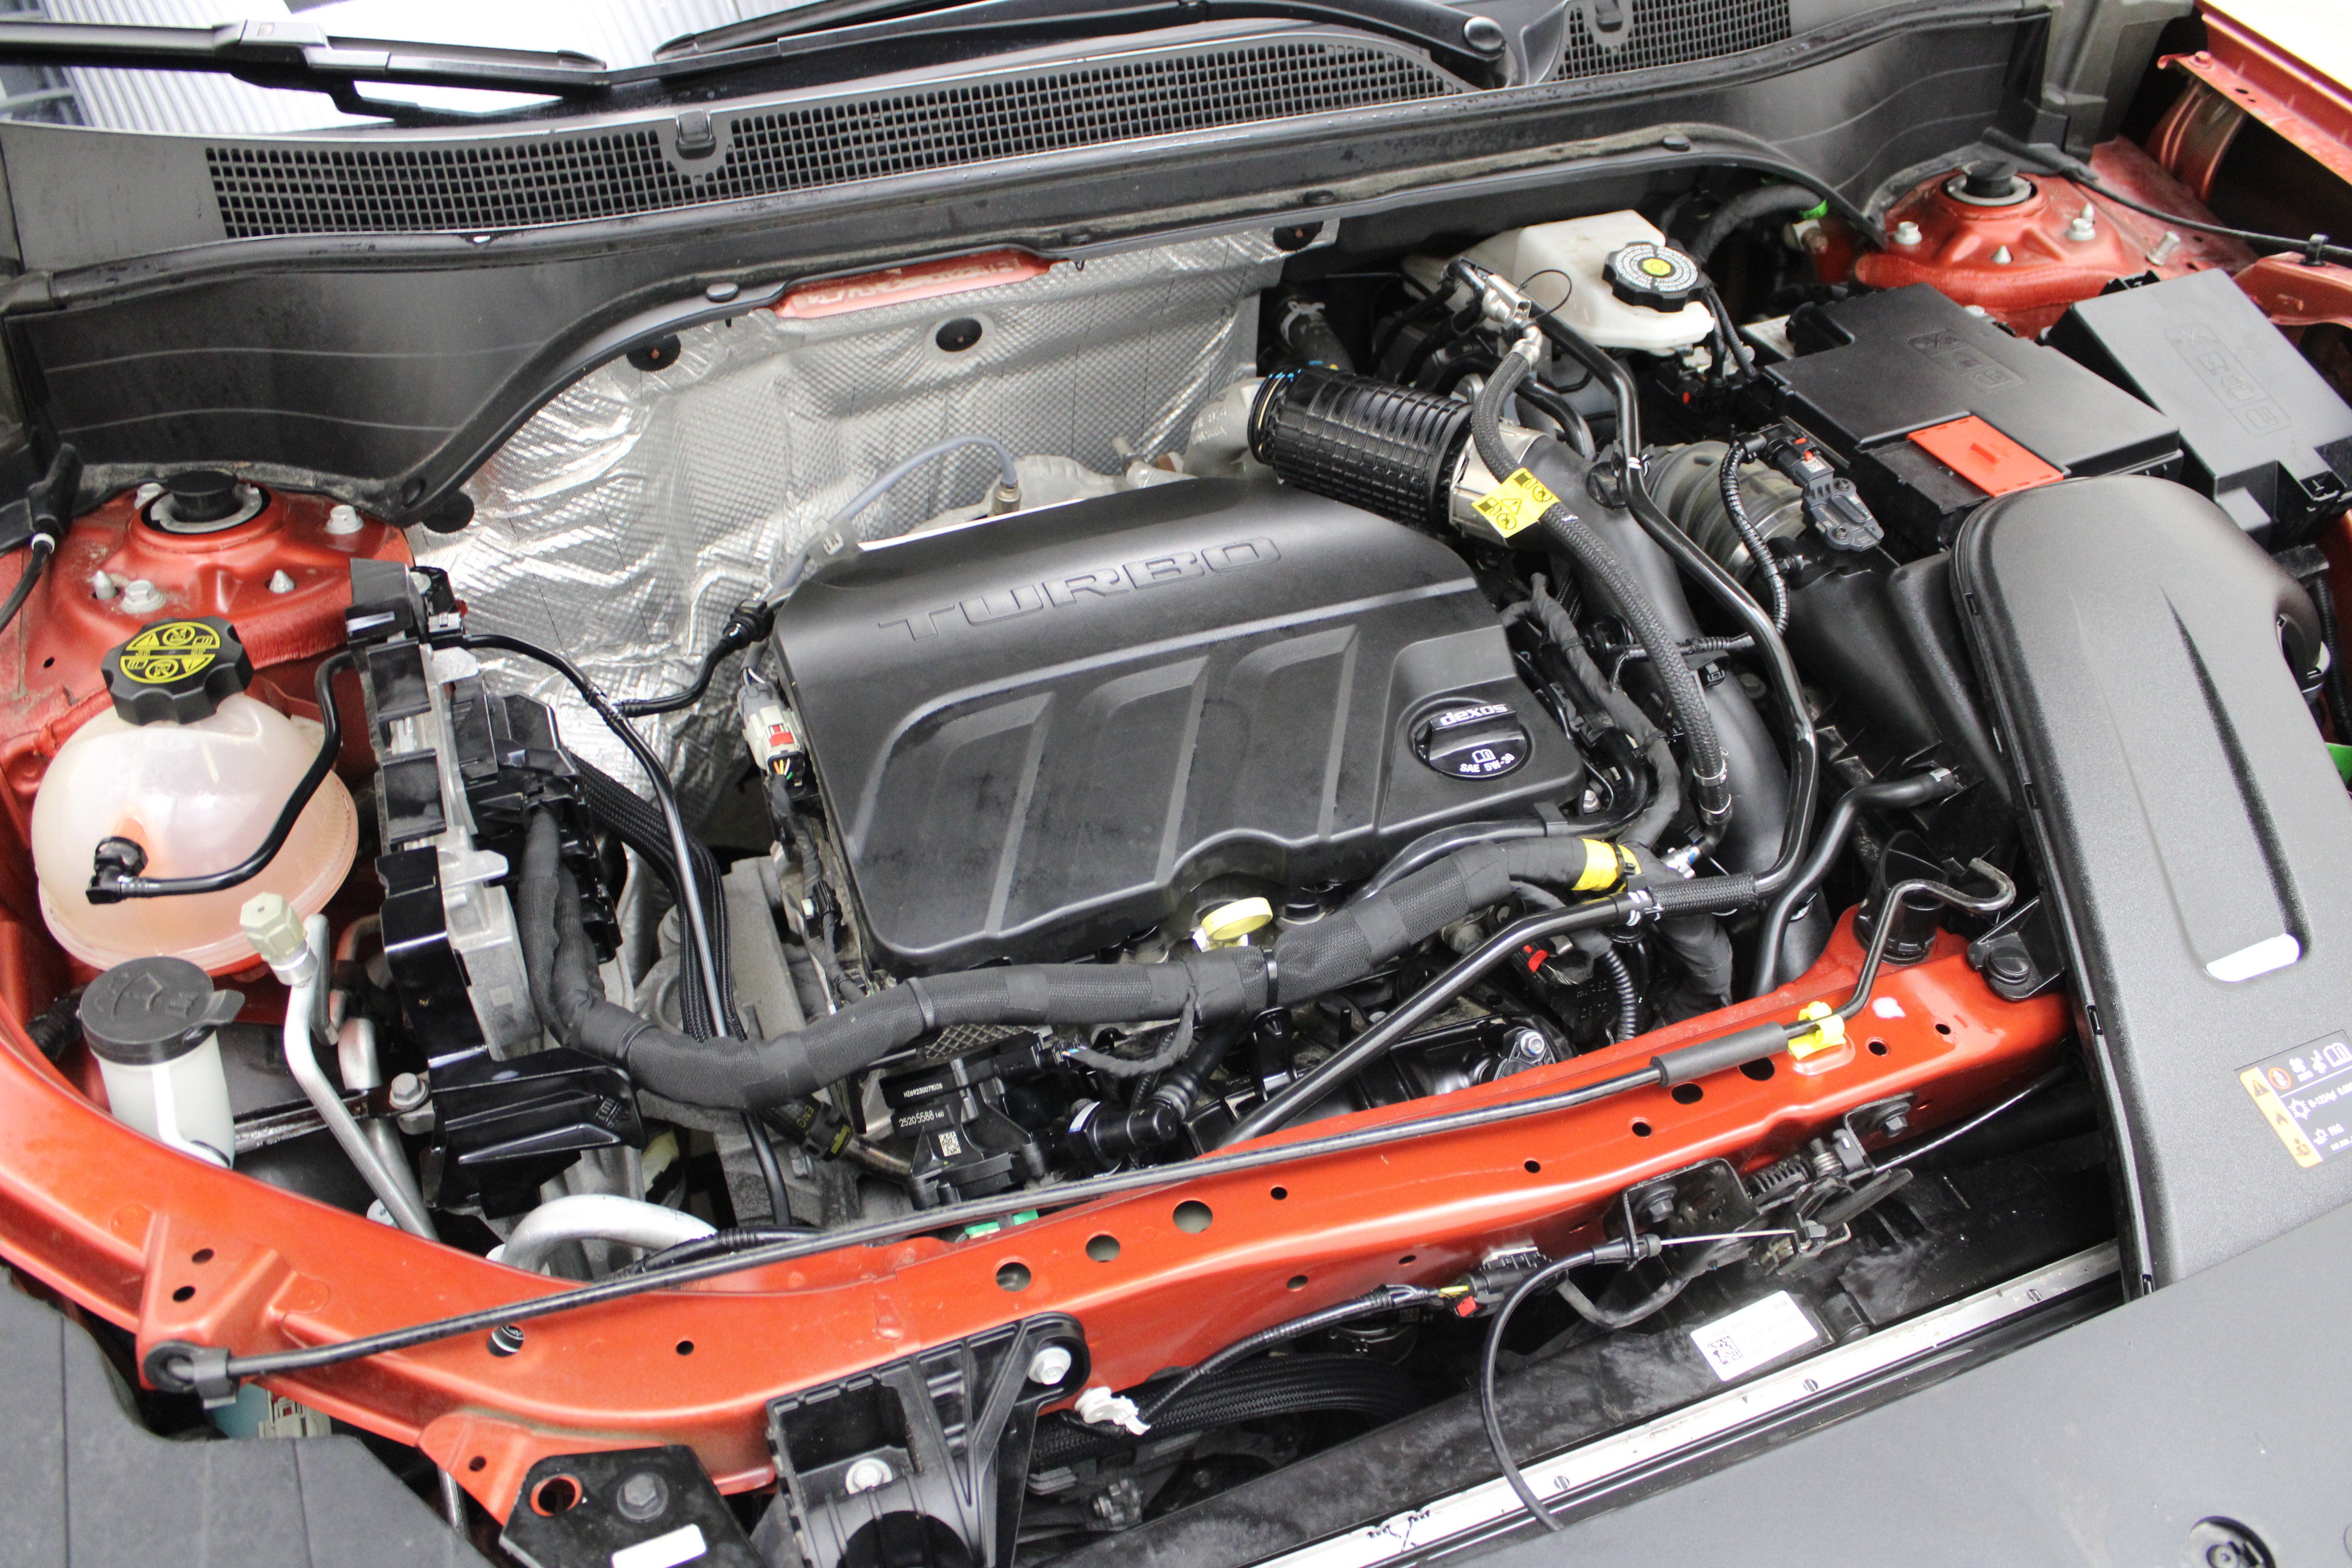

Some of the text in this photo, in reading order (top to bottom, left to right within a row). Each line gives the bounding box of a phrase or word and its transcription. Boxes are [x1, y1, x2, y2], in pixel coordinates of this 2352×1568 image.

[878, 537, 1282, 642] TURBO
[1440, 704, 1508, 726] dexos
[1459, 753, 1515, 773] SAE 5W-30
